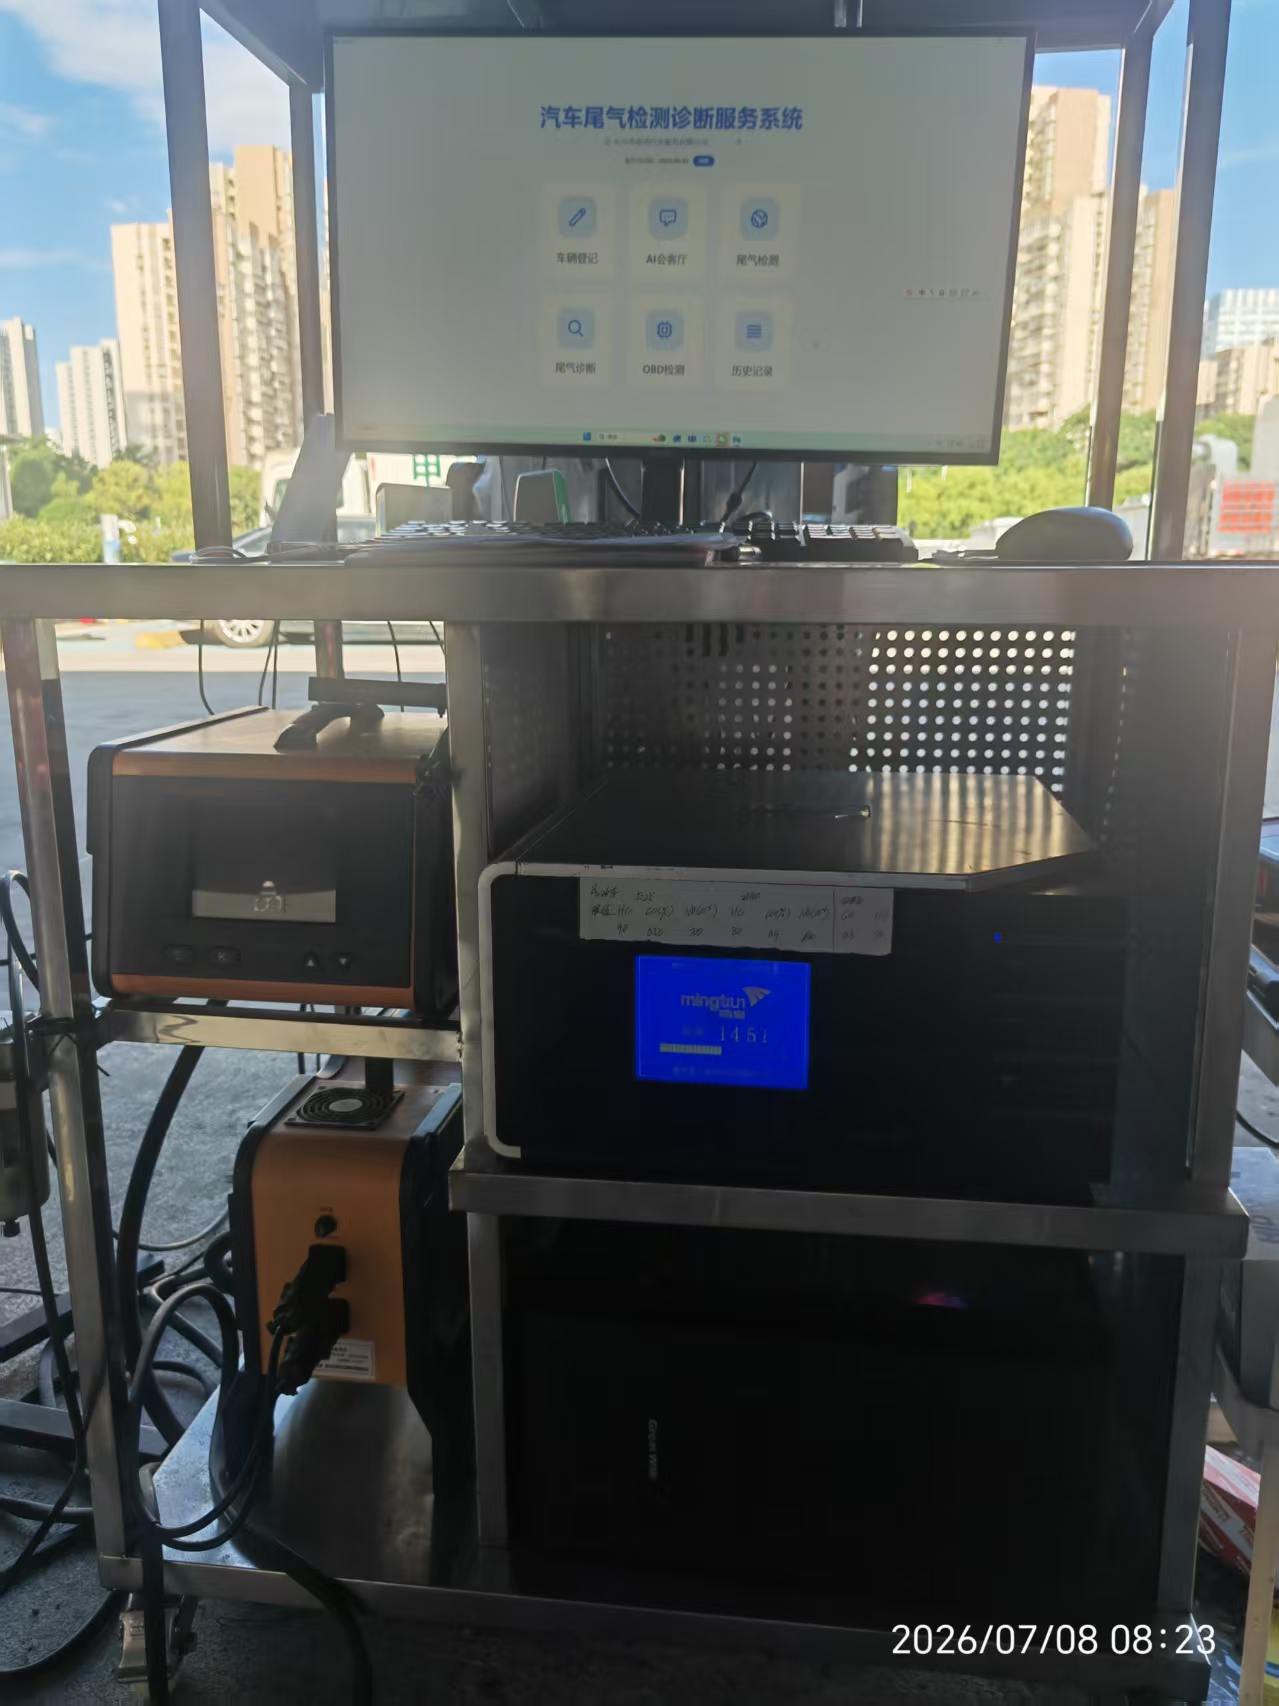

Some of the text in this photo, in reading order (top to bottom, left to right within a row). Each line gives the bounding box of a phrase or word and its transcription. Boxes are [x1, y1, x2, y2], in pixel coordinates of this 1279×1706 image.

[540, 105, 804, 130] 汽车尾气检测诊断服务系统
[556, 252, 599, 265] 车辆登记
[736, 254, 780, 267] 尾气检测
[555, 362, 597, 375] 尾气诊断
[642, 364, 686, 377] OBD检测
[731, 365, 773, 378] 历史记录
